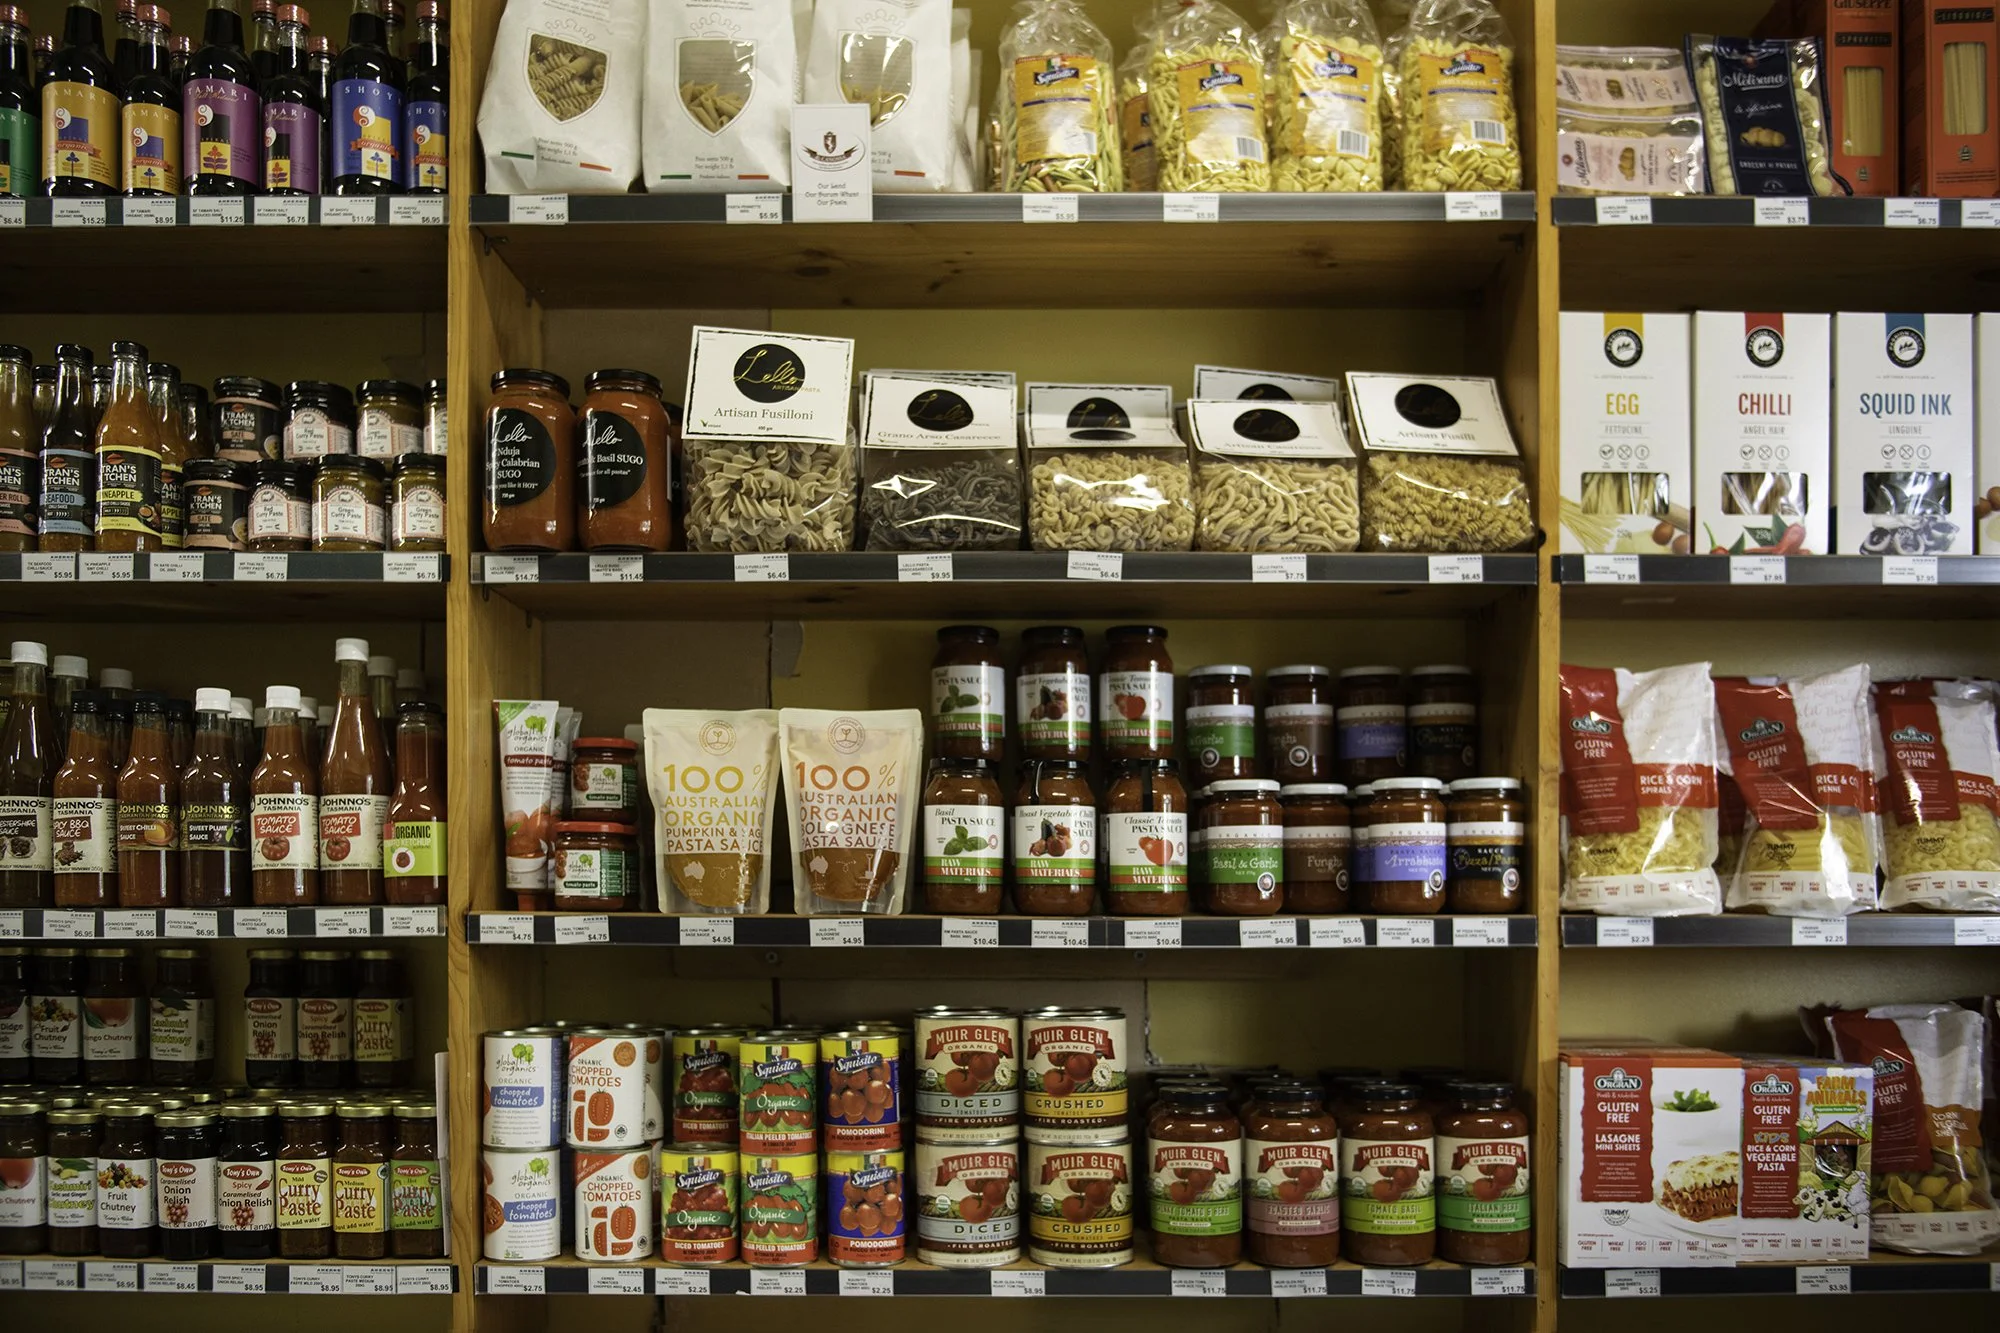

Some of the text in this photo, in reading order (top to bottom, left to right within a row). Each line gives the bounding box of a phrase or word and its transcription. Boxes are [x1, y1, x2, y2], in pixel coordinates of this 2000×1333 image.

[805, 190, 817, 198] Our
[545, 212, 566, 220] $5.95
[733, 350, 804, 386] Lello
[1606, 393, 1640, 416] EGG
[1739, 393, 1792, 416] CHILLI
[1859, 393, 1951, 419] SQUID INK
[714, 407, 814, 422] Artisan Fusilloni
[491, 416, 532, 444] Lello
[1604, 425, 1643, 435] FETTUCINE
[1743, 426, 1786, 435] ANGEL HAIR
[1888, 425, 1922, 435] LINGUINE
[878, 432, 913, 441] Grano
[917, 433, 943, 441] Arso
[500, 459, 541, 468] Calabrian
[597, 454, 644, 467] Basil SUGO
[101, 464, 137, 475] TRAN'S
[497, 470, 522, 479] SUGO
[101, 489, 135, 500] INEAPPLE
[193, 496, 223, 505] TRAN'S
[54, 571, 73, 579] $5.95
[182, 571, 202, 579] $7.95
[417, 571, 436, 579] $6.75
[620, 573, 644, 581] $11.45
[1575, 740, 1614, 752] GLUTEN
[1584, 748, 1607, 760] FREE
[1896, 750, 1936, 761] GLUTEN
[1907, 759, 1929, 768] FREE
[664, 763, 744, 794] 100
[796, 762, 870, 792] 100
[1640, 775, 1663, 787] RICE
[1676, 775, 1702, 787] CORN
[1816, 775, 1837, 785] RICE
[1640, 786, 1673, 794] SPIRALS
[1817, 785, 1842, 794] PENNE
[257, 797, 310, 806] JOHNNO'S
[322, 797, 372, 806] JOHNNO'S
[665, 796, 766, 808] AUSTRALIAN
[800, 792, 897, 805] AUSTRALIAN
[54, 800, 103, 811] JOHNNO'S
[58, 810, 93, 818] TASMANIA
[800, 806, 896, 822] ORGANIC
[935, 808, 955, 817] Basil
[256, 815, 298, 828] TOMATO
[321, 815, 358, 828] TOMATO
[665, 811, 765, 827] ORGANIC
[941, 816, 996, 827] PASTA SAUCE
[1124, 815, 1152, 825] Classic
[70, 820, 90, 832] BBQ
[261, 824, 293, 836] SAUCE
[327, 824, 355, 836] SAUCE
[1132, 825, 1160, 833] PASTA
[57, 831, 82, 841] SAUCE
[396, 825, 432, 841] ORGANIC
[667, 827, 738, 838] PUMPKIN &
[667, 839, 715, 852] PASTA
[940, 858, 961, 867] RAW
[1213, 856, 1236, 870] Basil
[1249, 856, 1280, 869] Garlic
[266, 928, 286, 936] $6.95
[416, 927, 436, 935] $5.45
[512, 933, 532, 941] $4.75
[712, 936, 732, 944] $4.95
[1825, 935, 1844, 943] $2.25
[936, 1029, 1005, 1045] MUIR GLEN
[1034, 1029, 1104, 1046] MUIR GLEN
[948, 1043, 994, 1052] ORGANIC
[836, 1055, 878, 1073] Squisito
[1597, 1078, 1639, 1090] ORGRAN
[1816, 1075, 1856, 1090] FARM
[499, 1087, 531, 1099] chopped
[1806, 1090, 1868, 1106] ANIMALS
[494, 1095, 539, 1108] tomatoes
[756, 1092, 799, 1116] Organic
[941, 1097, 1002, 1109] DICED
[1035, 1098, 1104, 1110] CRUSHED
[1598, 1101, 1640, 1113] GLUTEN
[1753, 1104, 1791, 1116] GLUTEN
[966, 1116, 1002, 1124] ROASTED
[1607, 1112, 1630, 1124] FREE
[1761, 1114, 1782, 1124] FREE
[836, 1127, 885, 1136] POMODORINI
[1596, 1133, 1641, 1144] LASAGNE
[1596, 1143, 1641, 1151] MINI SHEETS
[1747, 1144, 1796, 1153] RICE & CORN
[1746, 1153, 1797, 1163] VEGETABLE
[1757, 1162, 1786, 1172] PASTA
[226, 1168, 260, 1180] Tony's Own
[597, 1174, 623, 1182] ORGANIC
[677, 1171, 719, 1190] Squisito
[163, 1185, 192, 1195] Onion
[278, 1178, 319, 1202] Curry
[334, 1180, 375, 1203] Curry
[588, 1181, 634, 1192] CHOPPED
[107, 1192, 128, 1201] Fruit
[163, 1196, 191, 1206] Relish
[582, 1190, 642, 1202] TOMATOES
[100, 1201, 137, 1215] Chutney
[280, 1199, 319, 1217] Paste
[335, 1202, 375, 1220] Paste
[674, 1241, 725, 1250] DICED TOMATOES
[177, 1282, 196, 1290] $8.45
[429, 1284, 449, 1292] $8.95
[523, 1284, 543, 1292] $2.75
[784, 1286, 804, 1294] $2.25
[1502, 1286, 1526, 1294] $11.75
